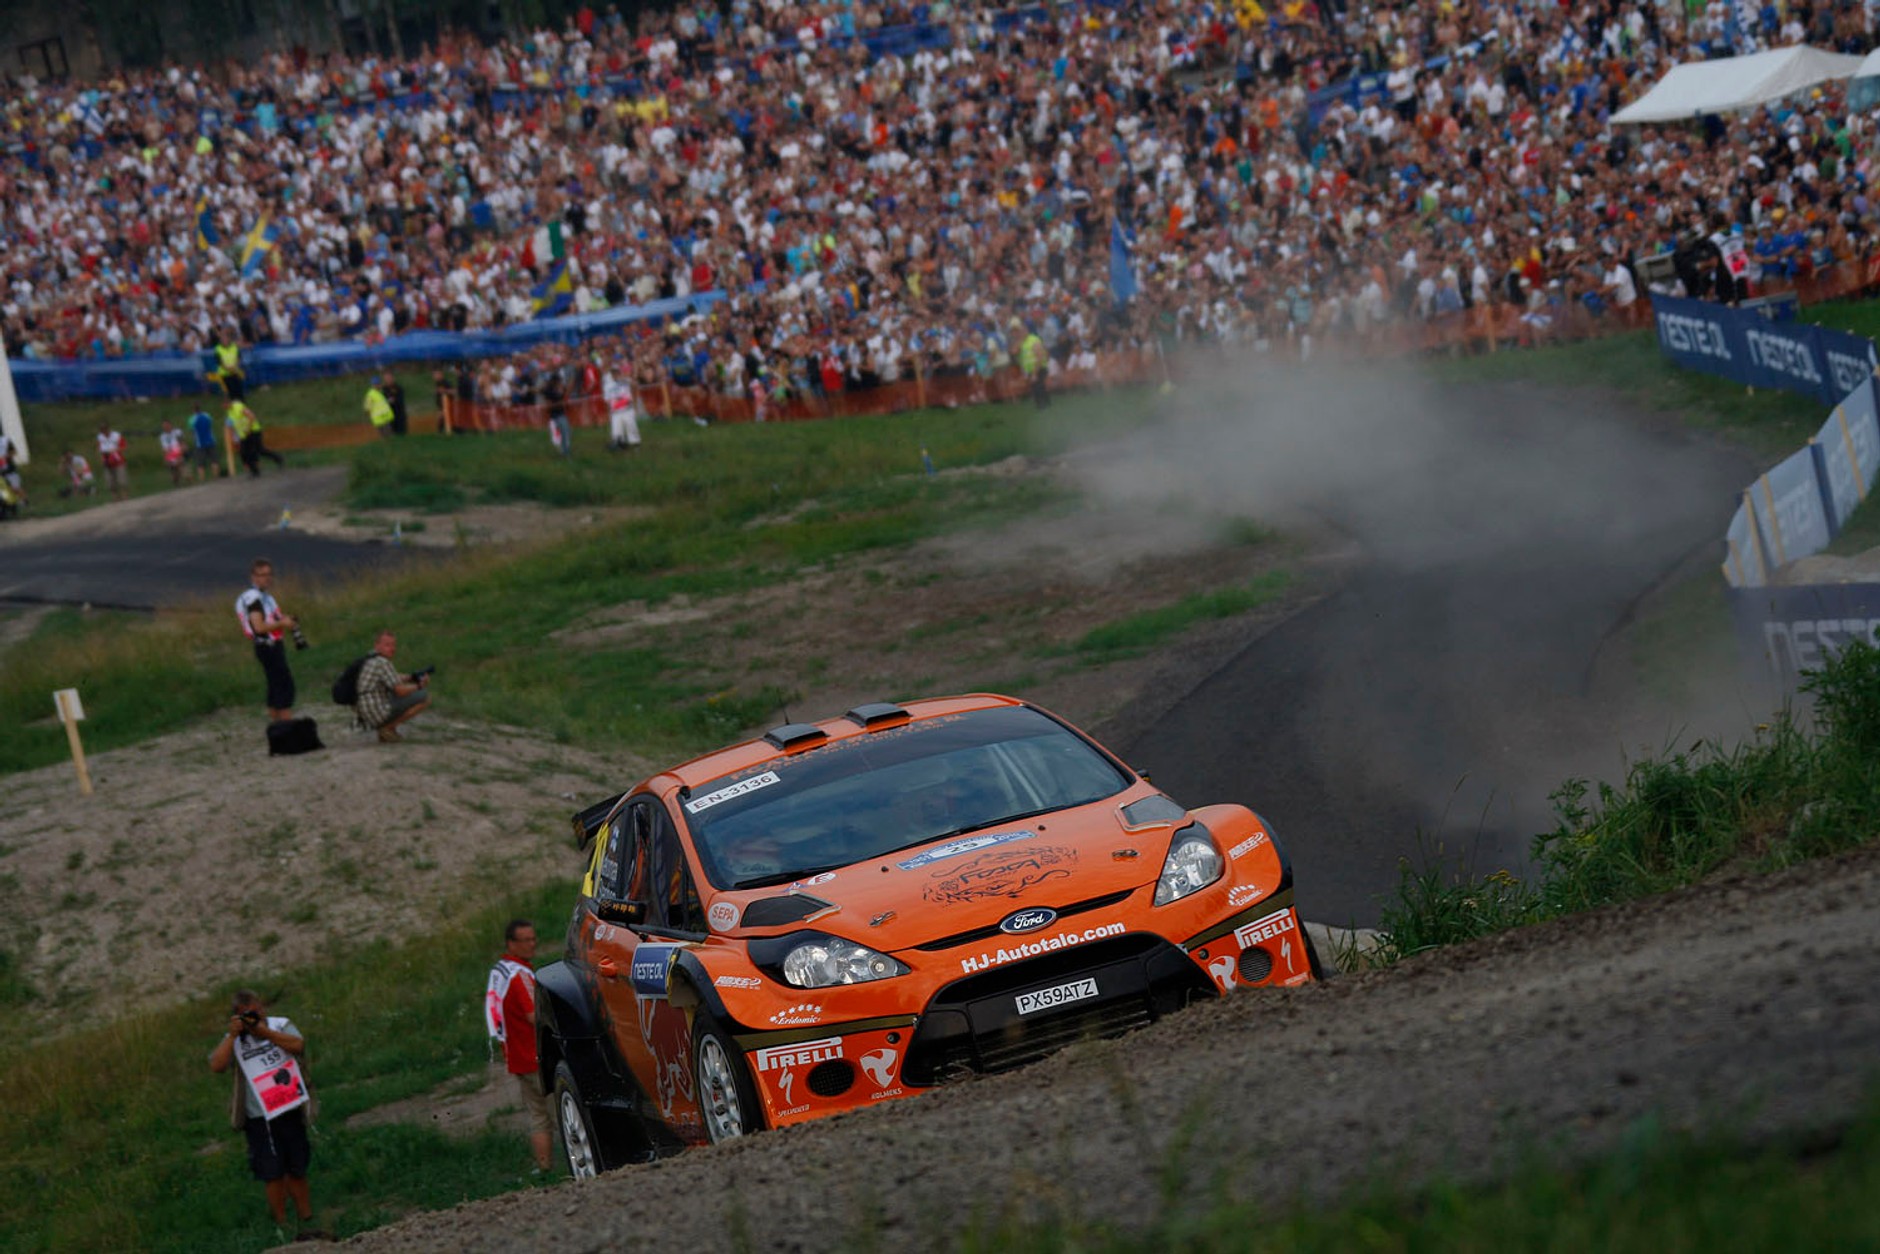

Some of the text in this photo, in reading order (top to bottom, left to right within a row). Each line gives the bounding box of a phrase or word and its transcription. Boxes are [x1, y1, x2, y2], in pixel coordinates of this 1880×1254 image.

[693, 775, 772, 809] EN-3136
[712, 906, 735, 922] SEPA
[1013, 912, 1045, 930] Ford
[1233, 908, 1295, 950] PIRELLI
[961, 922, 1126, 973] HJ-Autotalo.com
[1020, 981, 1094, 1011] PX59ATZ
[756, 1036, 844, 1071] PIRELLI
